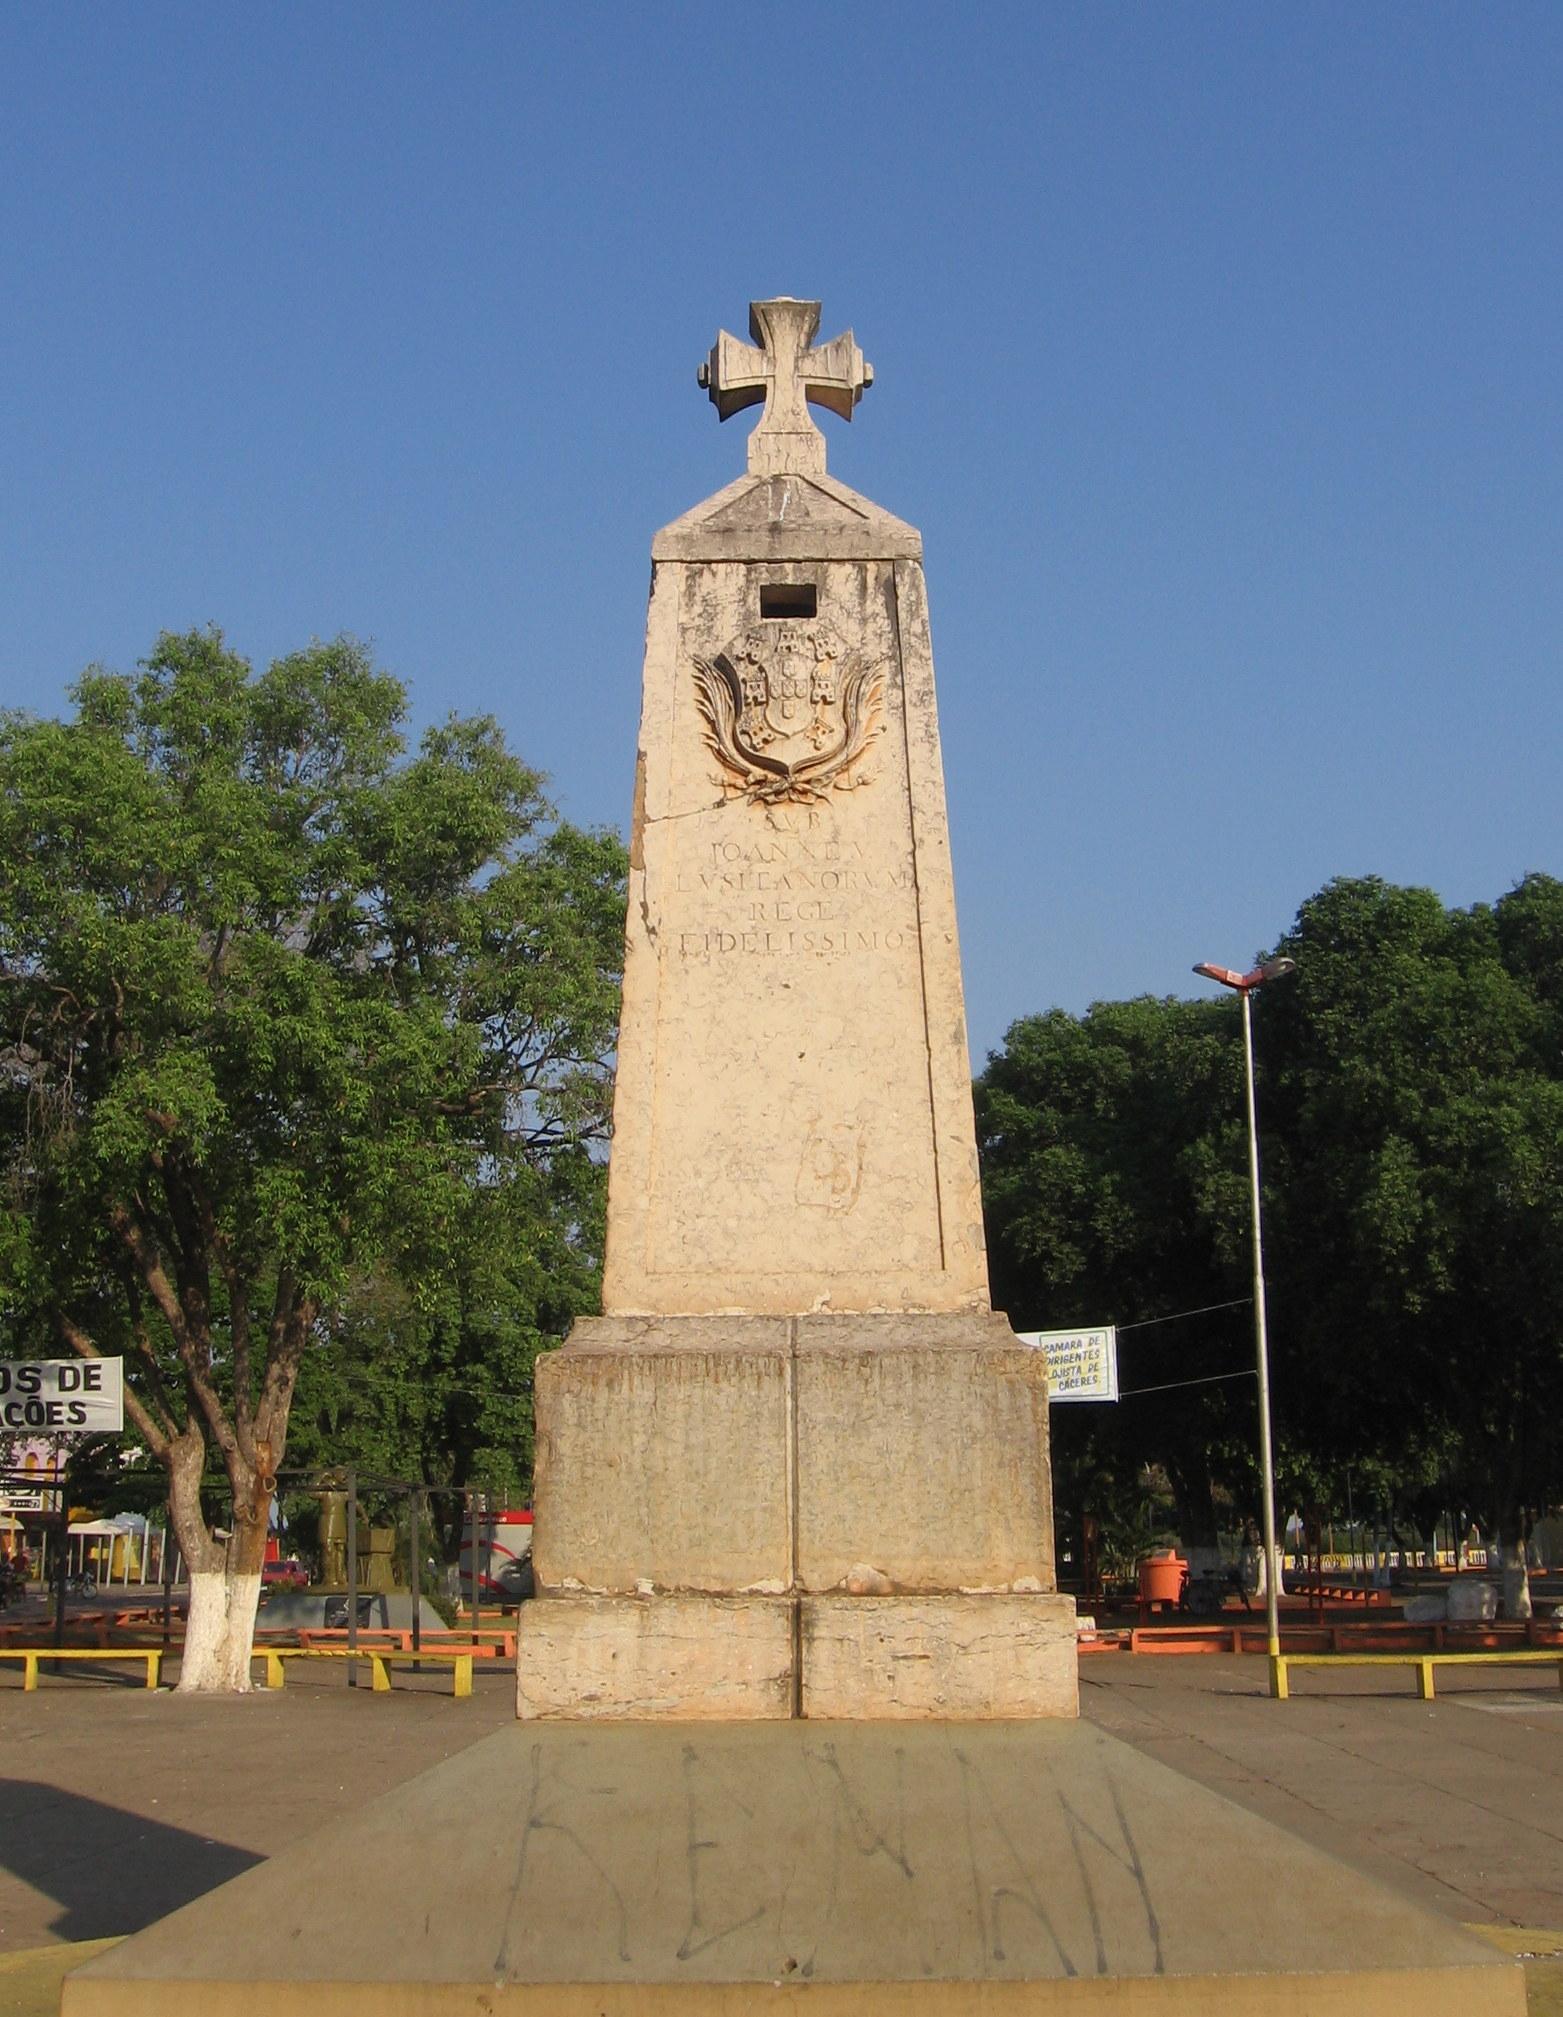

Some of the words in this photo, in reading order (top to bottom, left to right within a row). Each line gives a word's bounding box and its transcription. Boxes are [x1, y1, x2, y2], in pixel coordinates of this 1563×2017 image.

[749, 900, 834, 922] REGE
[680, 929, 905, 953] FIDELISSIMO
[1088, 1336, 1101, 1347] DE
[58, 1364, 102, 1392] DE
[1088, 1362, 1100, 1373] DE
[0, 1396, 87, 1429] ÇÕES
